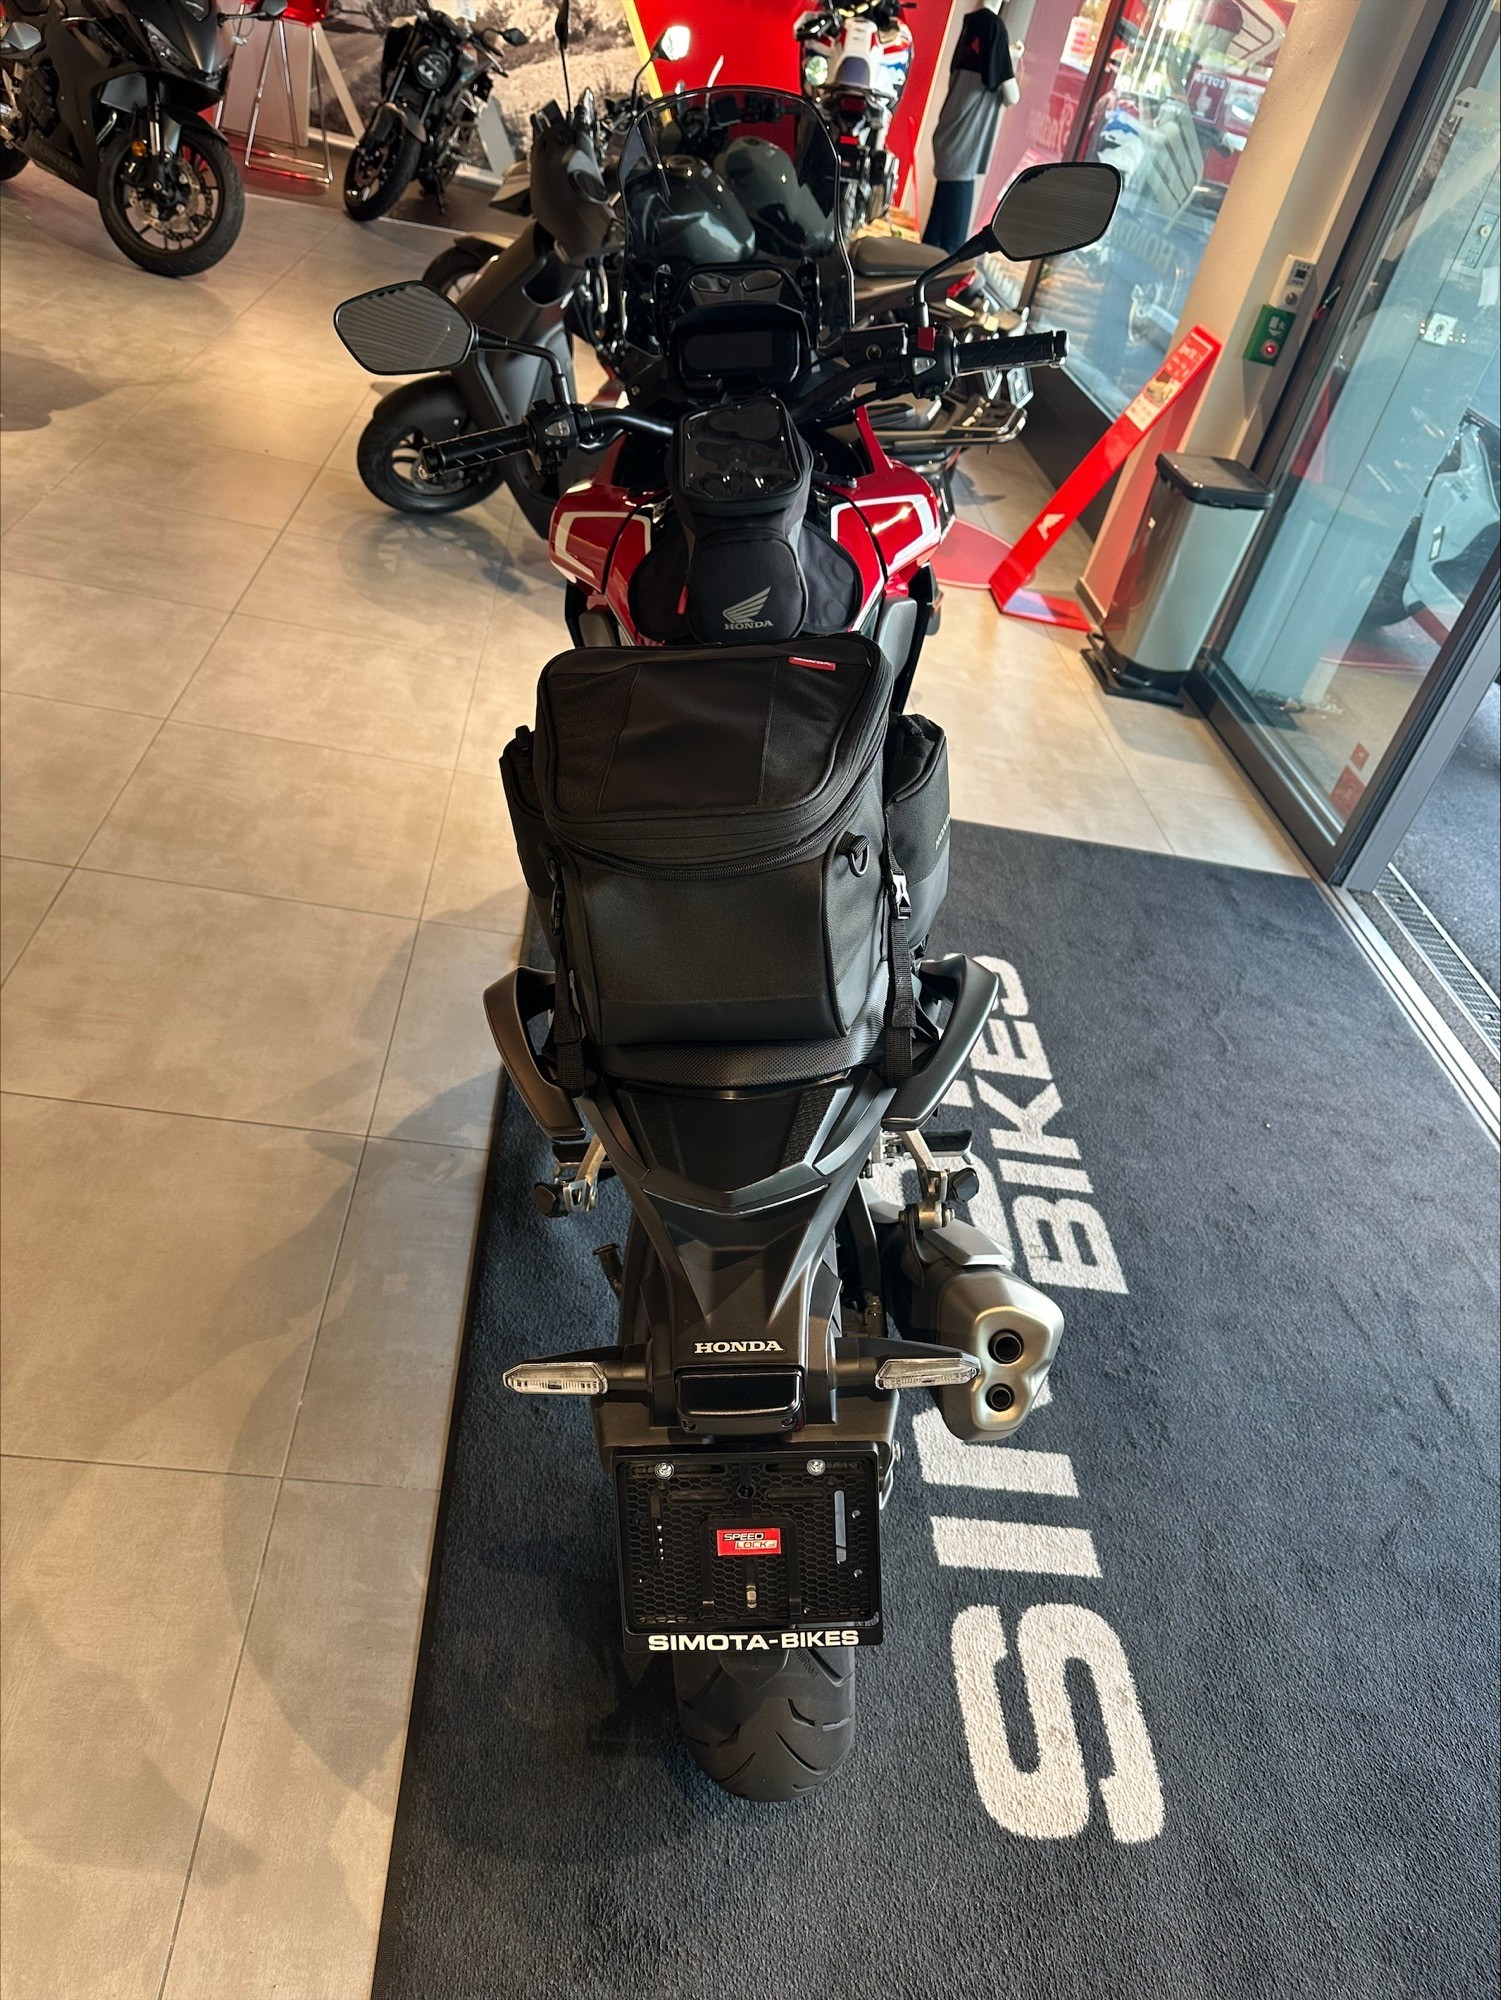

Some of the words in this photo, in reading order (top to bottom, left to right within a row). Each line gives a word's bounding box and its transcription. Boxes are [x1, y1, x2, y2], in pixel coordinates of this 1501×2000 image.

[724, 620, 774, 630] HONDA
[694, 1340, 784, 1354] HONDA
[723, 1532, 765, 1541] SPEED
[736, 1540, 768, 1549] LOCK
[648, 1629, 860, 1651] SIMOTA-BIKES
